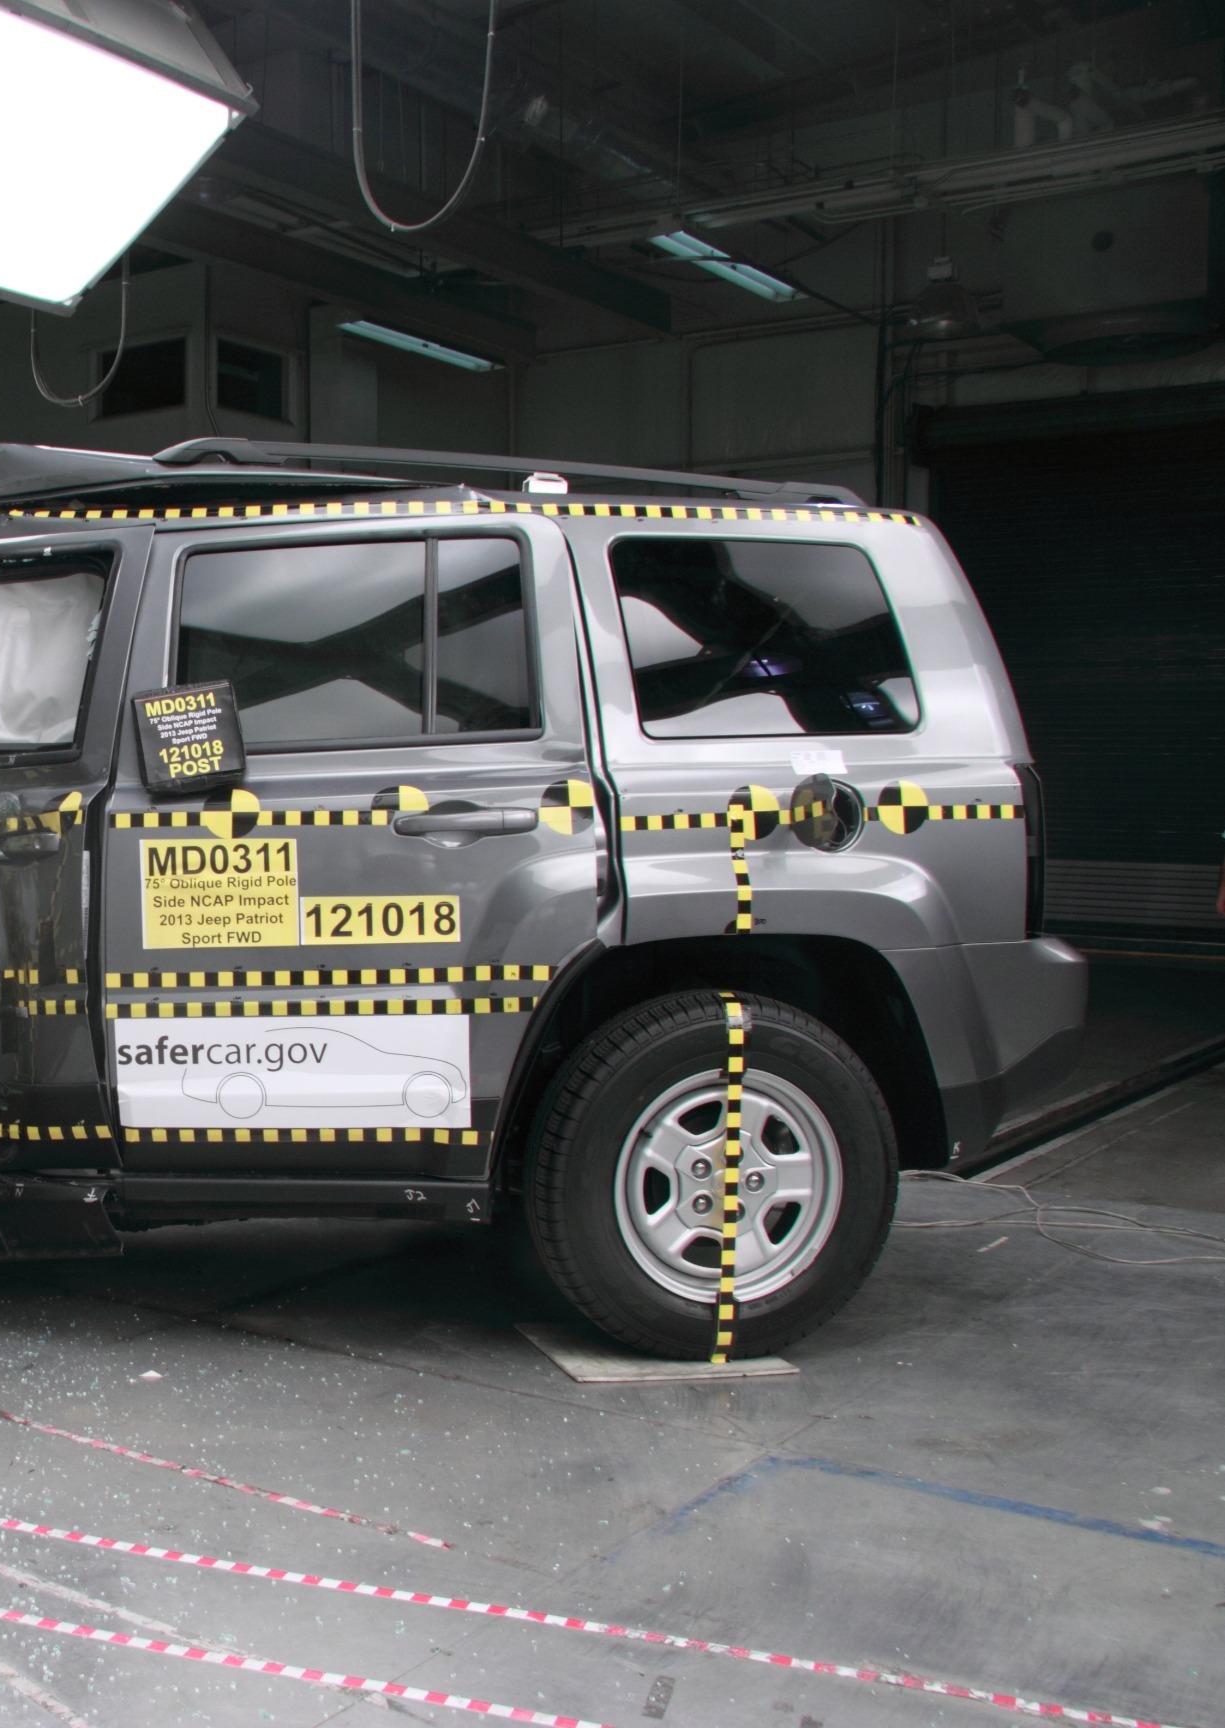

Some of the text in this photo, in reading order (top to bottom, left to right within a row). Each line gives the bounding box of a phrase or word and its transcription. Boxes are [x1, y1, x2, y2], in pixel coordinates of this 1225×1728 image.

[145, 692, 216, 717] MD0311
[161, 713, 188, 723] Oblique
[188, 710, 206, 719] Rigid
[206, 707, 222, 715] Pole
[157, 716, 217, 731] Side NCAP Impact
[160, 723, 217, 739] 2013 Jeep Patriot
[172, 732, 208, 745] Sport FWD
[159, 739, 224, 764] 121018
[169, 756, 222, 778] POST
[147, 842, 291, 877] MD0311
[170, 878, 223, 891] Oblique
[227, 876, 262, 890] Rigid
[267, 875, 297, 887] Pole
[153, 894, 290, 909] Side NCAP Impact
[160, 912, 284, 927] 2013 Jeep Patriot
[305, 901, 456, 938] 121018
[181, 931, 262, 946] Sport FWD
[117, 1035, 328, 1072] safercar.gov
